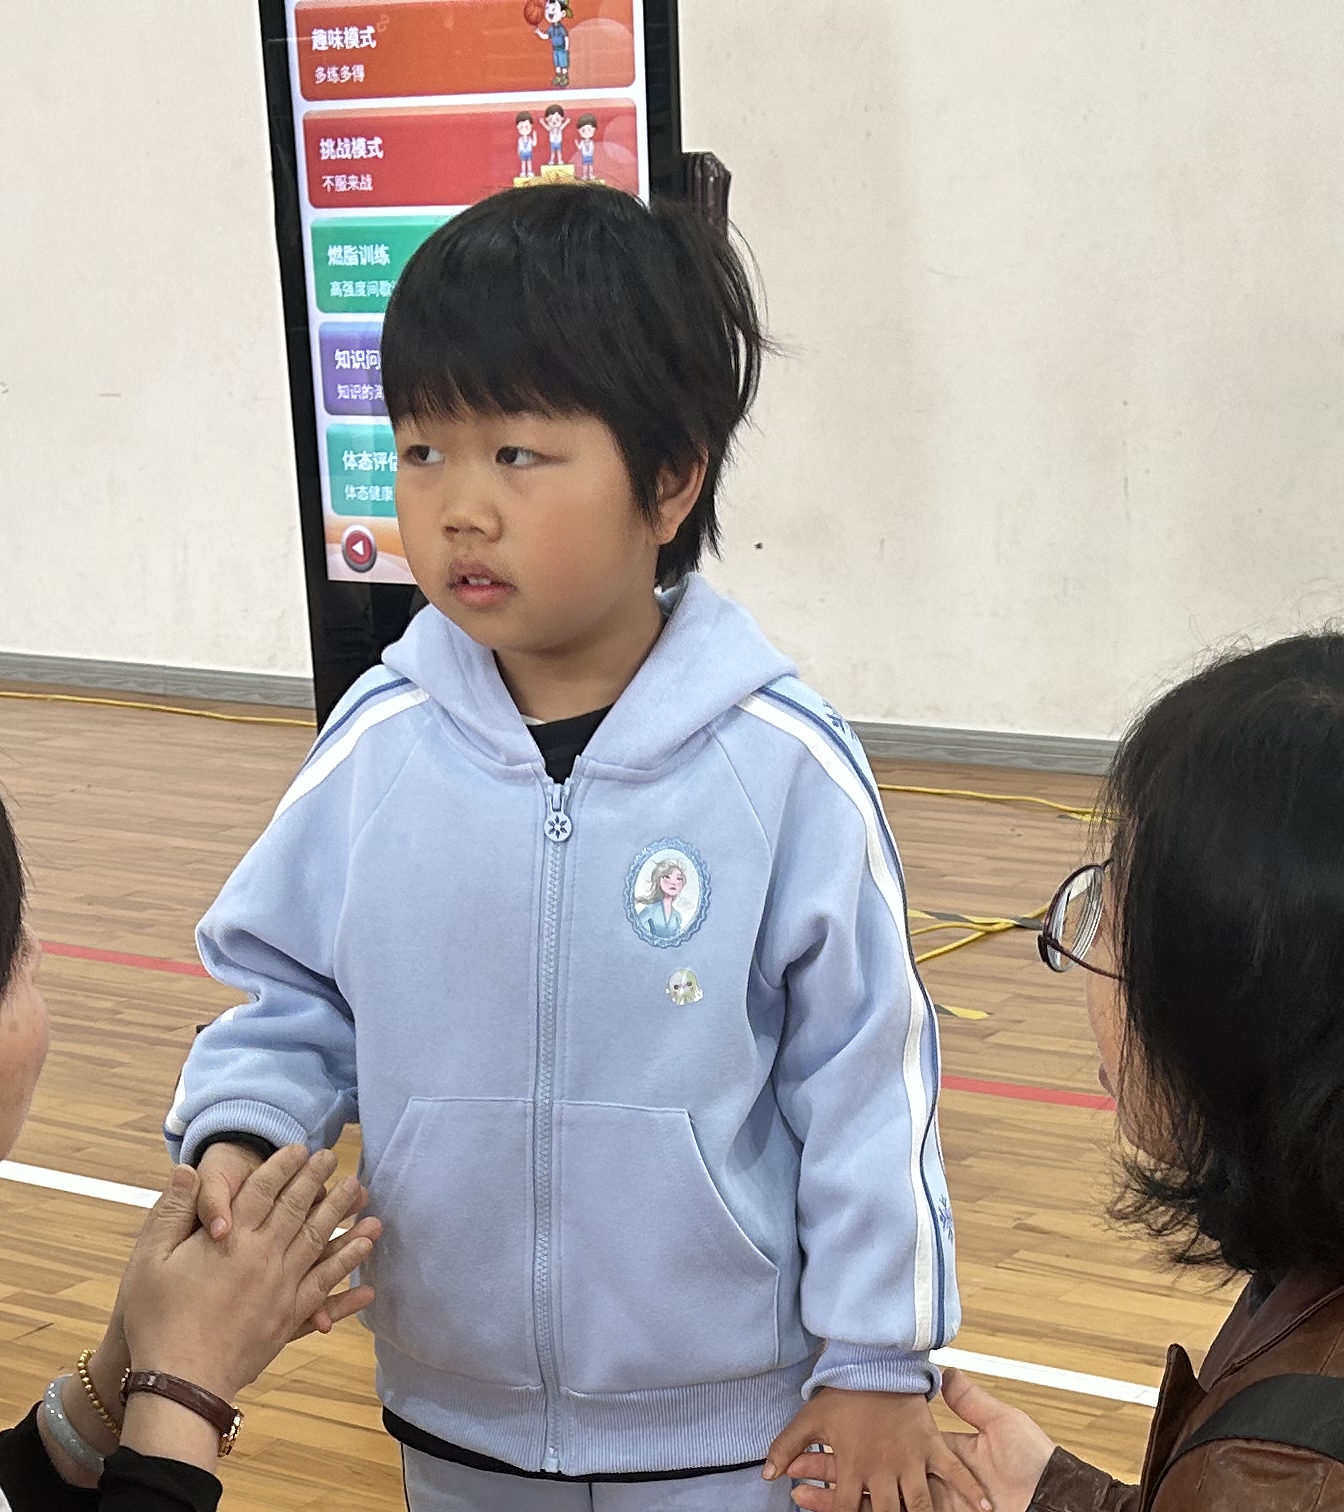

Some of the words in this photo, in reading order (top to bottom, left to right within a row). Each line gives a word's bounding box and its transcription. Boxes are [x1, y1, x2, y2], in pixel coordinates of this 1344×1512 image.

[311, 25, 377, 51] 趣味模式
[315, 64, 365, 84] 多练多得
[319, 136, 384, 160] 挑战模式
[321, 173, 373, 192] 不服来战
[328, 244, 390, 266] 燃脂训练
[335, 349, 381, 370] 知识问
[344, 484, 394, 501] 体态健康
